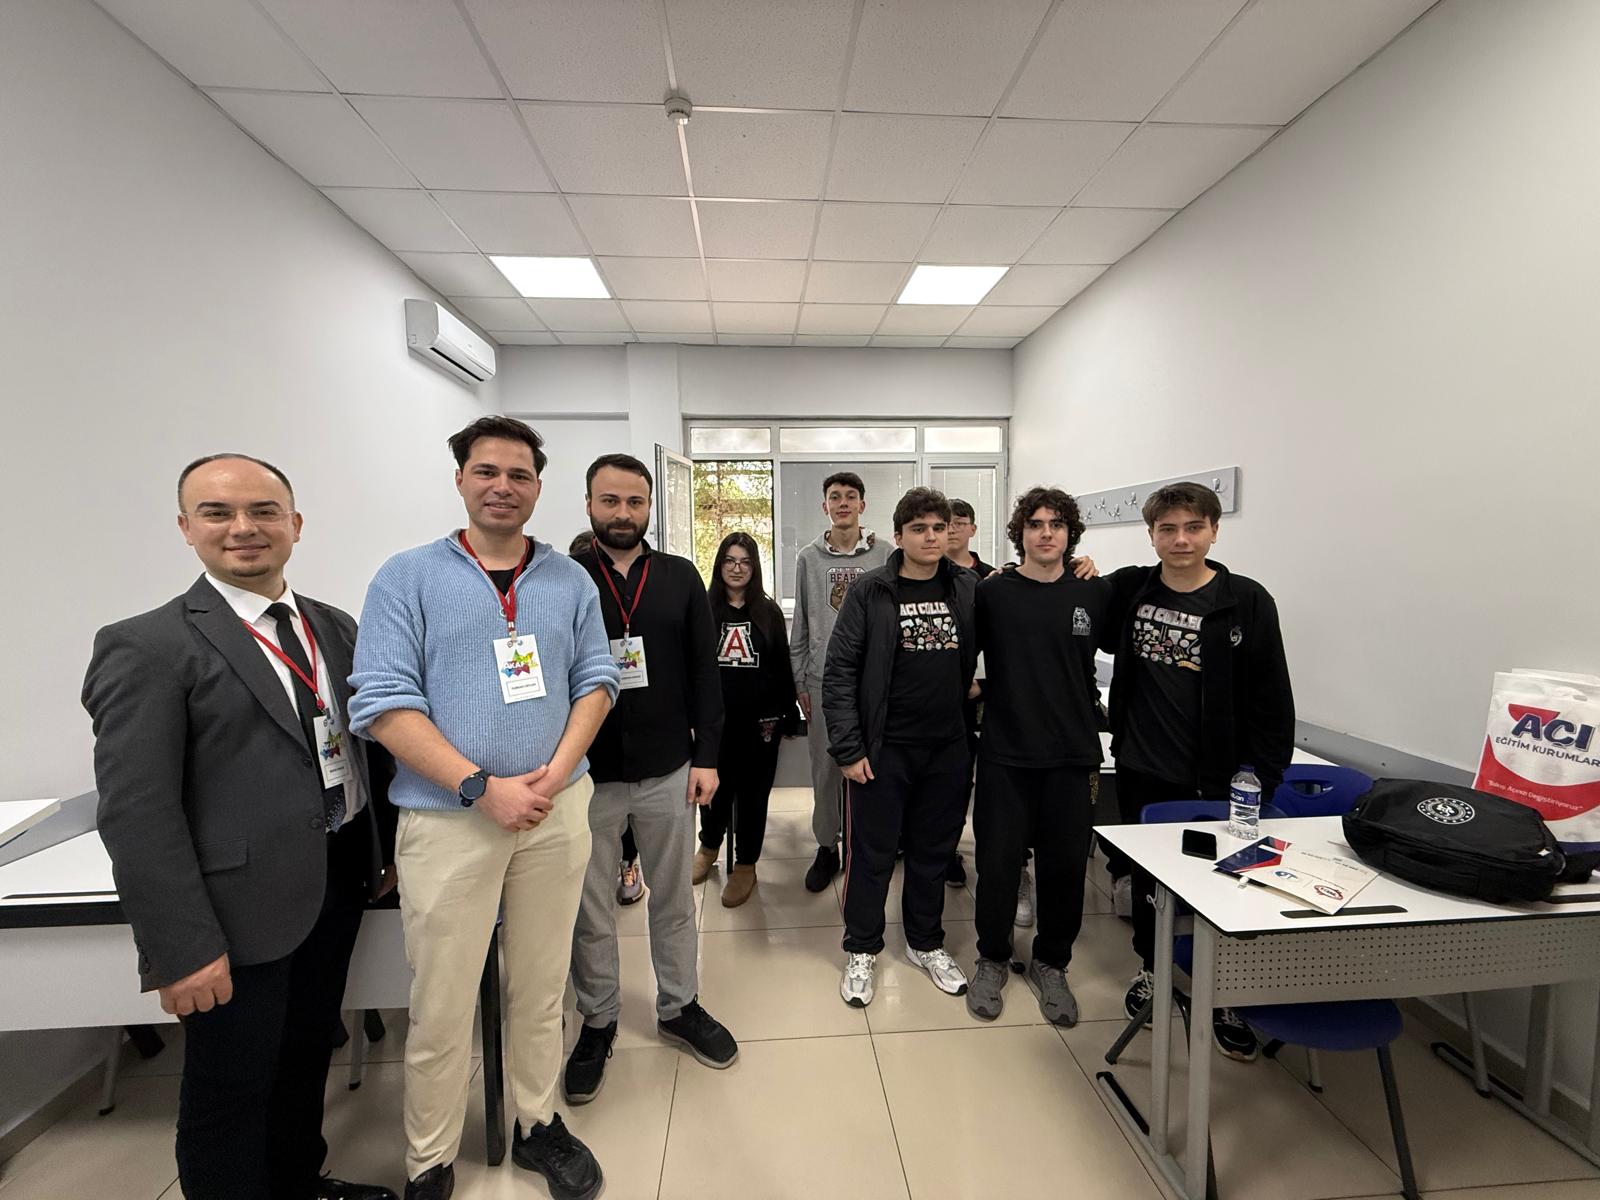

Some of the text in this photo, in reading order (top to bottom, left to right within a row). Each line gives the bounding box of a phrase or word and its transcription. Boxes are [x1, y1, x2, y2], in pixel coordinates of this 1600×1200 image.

[830, 573, 861, 583] BEAR
[917, 601, 950, 615] COLLE
[1153, 607, 1204, 632] COLLE
[717, 621, 760, 668] A
[1511, 712, 1596, 752] AÇI
[1495, 736, 1600, 768] EĞİTİM KURUMLAR
